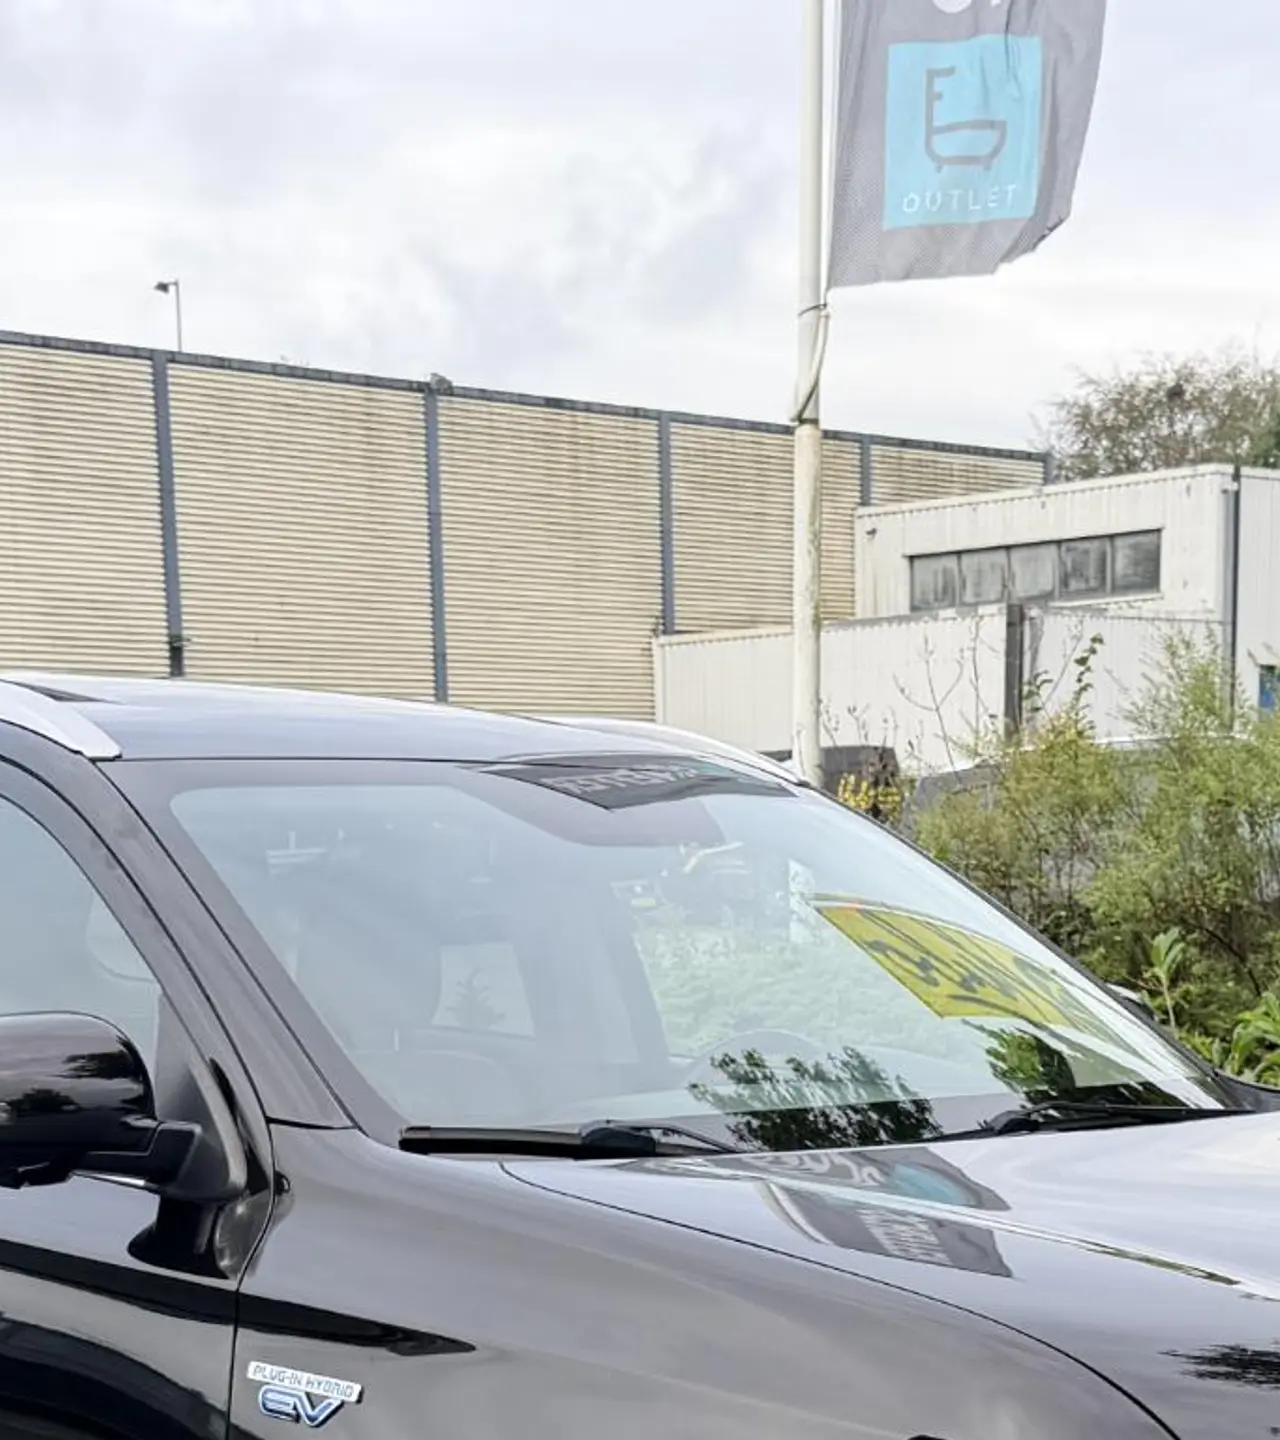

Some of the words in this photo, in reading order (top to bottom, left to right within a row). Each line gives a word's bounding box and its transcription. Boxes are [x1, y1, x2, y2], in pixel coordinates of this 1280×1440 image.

[902, 184, 1018, 214] OUTLET
[252, 1364, 303, 1387] PLUG-IN
[305, 1375, 355, 1399] HYBRID
[258, 1383, 345, 1427] EV
